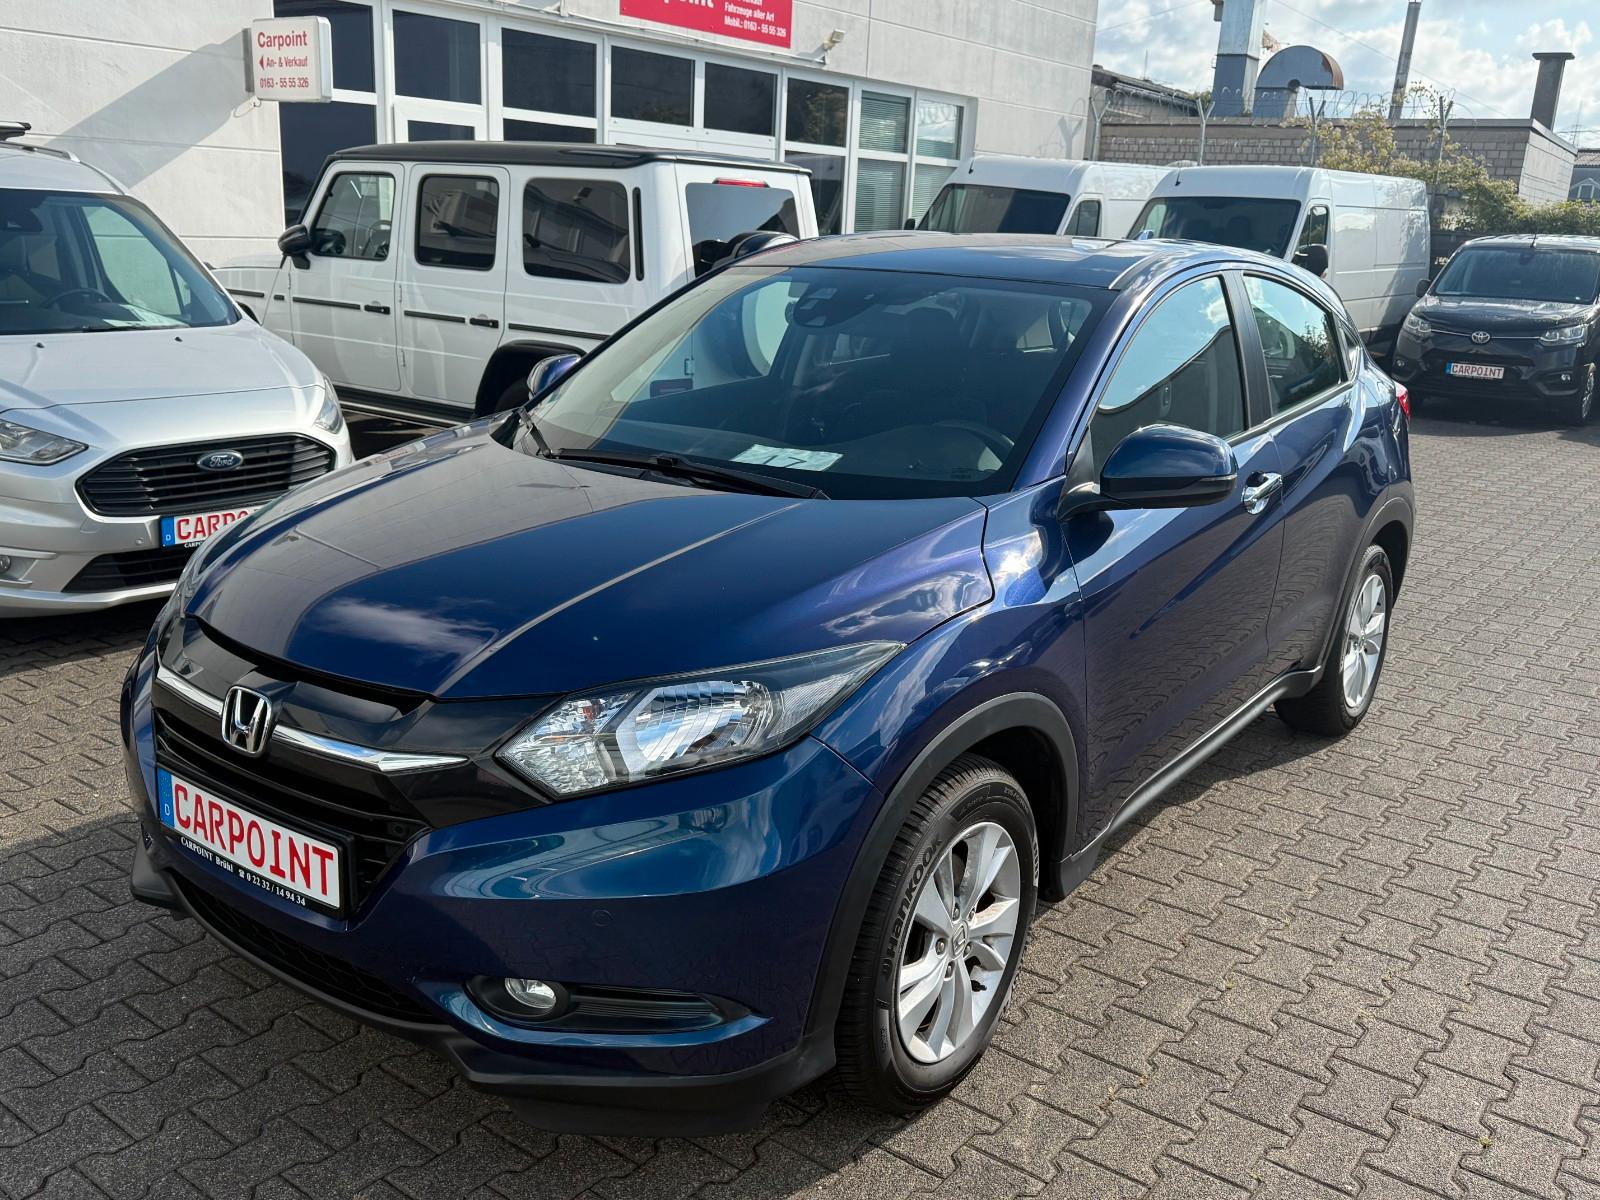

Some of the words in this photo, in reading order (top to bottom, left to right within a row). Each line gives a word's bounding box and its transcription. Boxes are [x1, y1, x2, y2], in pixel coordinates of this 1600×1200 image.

[766, 11, 774, 22] Art
[257, 30, 307, 51] Carpoint
[284, 56, 308, 67] Verkauf
[260, 78, 274, 89] 0163
[279, 77, 287, 88] 55
[288, 77, 296, 88] 55
[1452, 364, 1503, 378] CARPOINT
[209, 454, 234, 467] Ford
[177, 510, 249, 541] CARP
[164, 803, 171, 816] D
[174, 783, 334, 896] CARPOINT
[180, 836, 213, 861] CARPOINT
[215, 855, 234, 873] Brühl
[252, 875, 261, 886] 22
[261, 878, 271, 891] 32
[275, 886, 284, 897] 14
[285, 890, 295, 902] 94
[296, 895, 306, 907] 34
